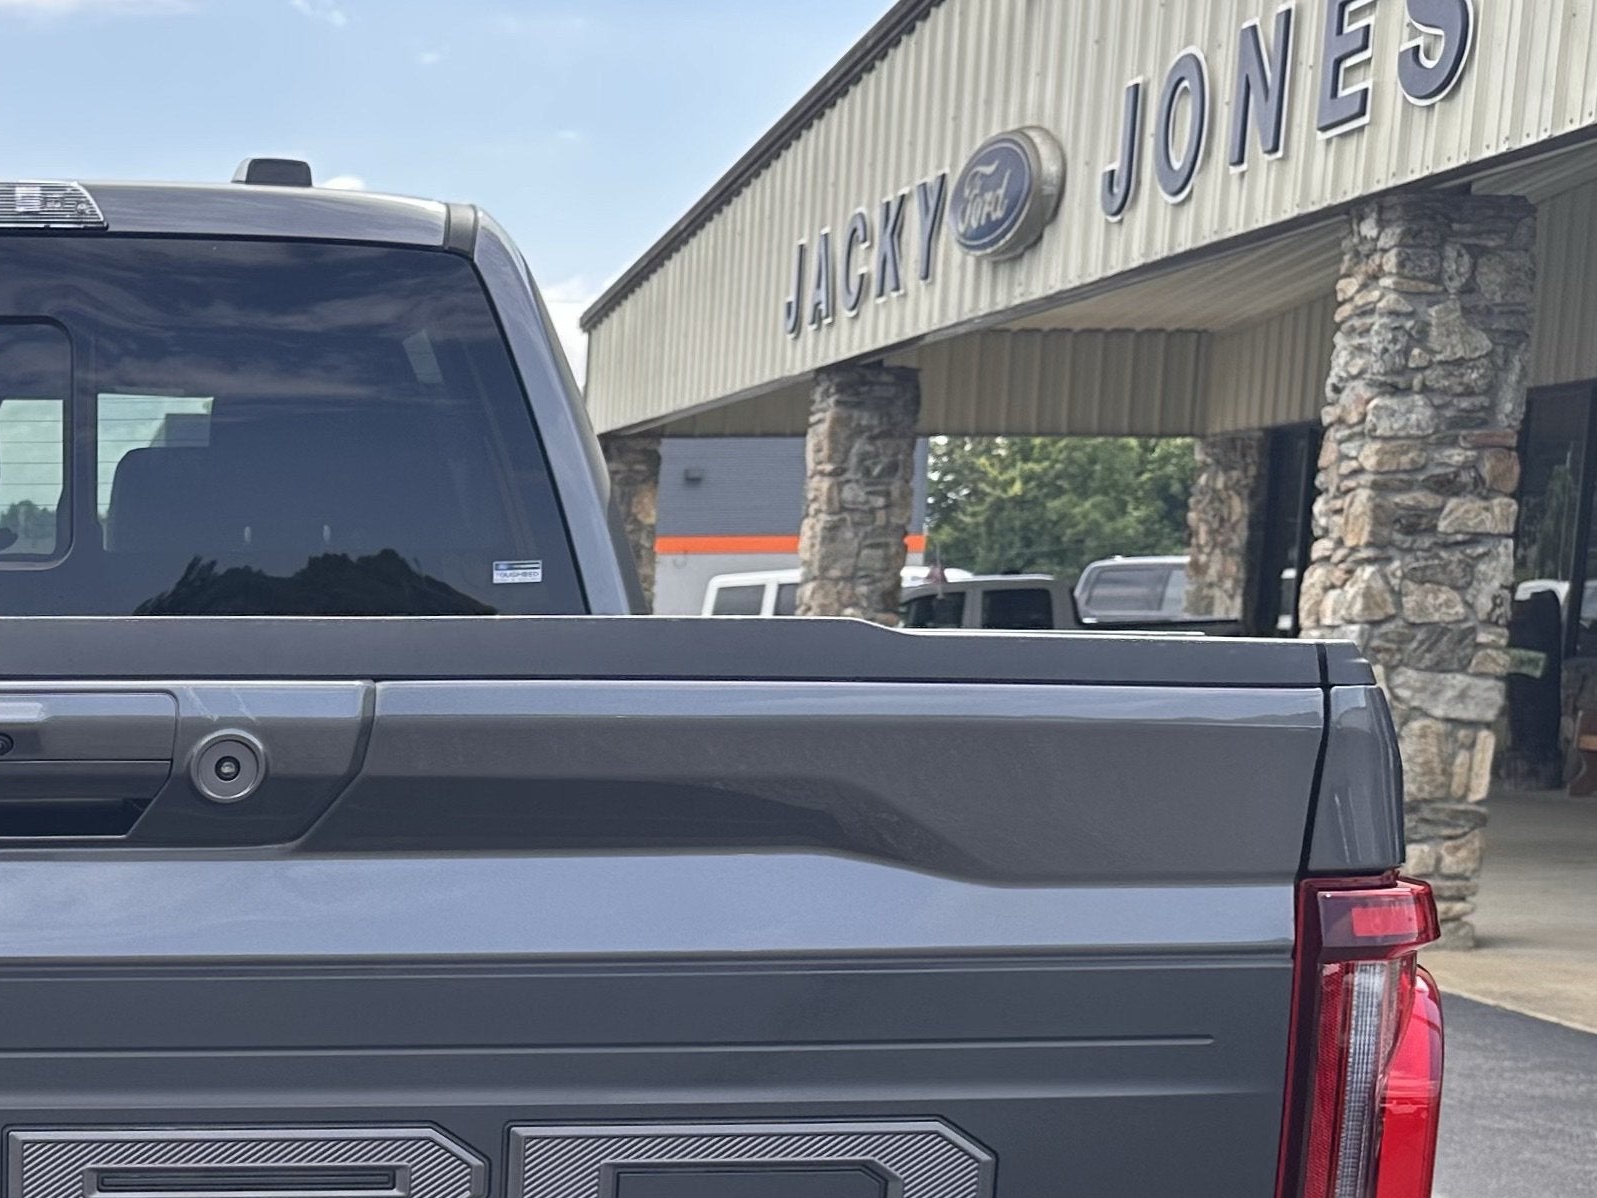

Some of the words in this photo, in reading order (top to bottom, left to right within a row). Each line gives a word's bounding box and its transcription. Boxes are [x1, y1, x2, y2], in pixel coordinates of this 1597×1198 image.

[784, 168, 950, 339] JACKY
[958, 160, 1011, 234] Ford
[1101, 0, 1473, 222] JONES
